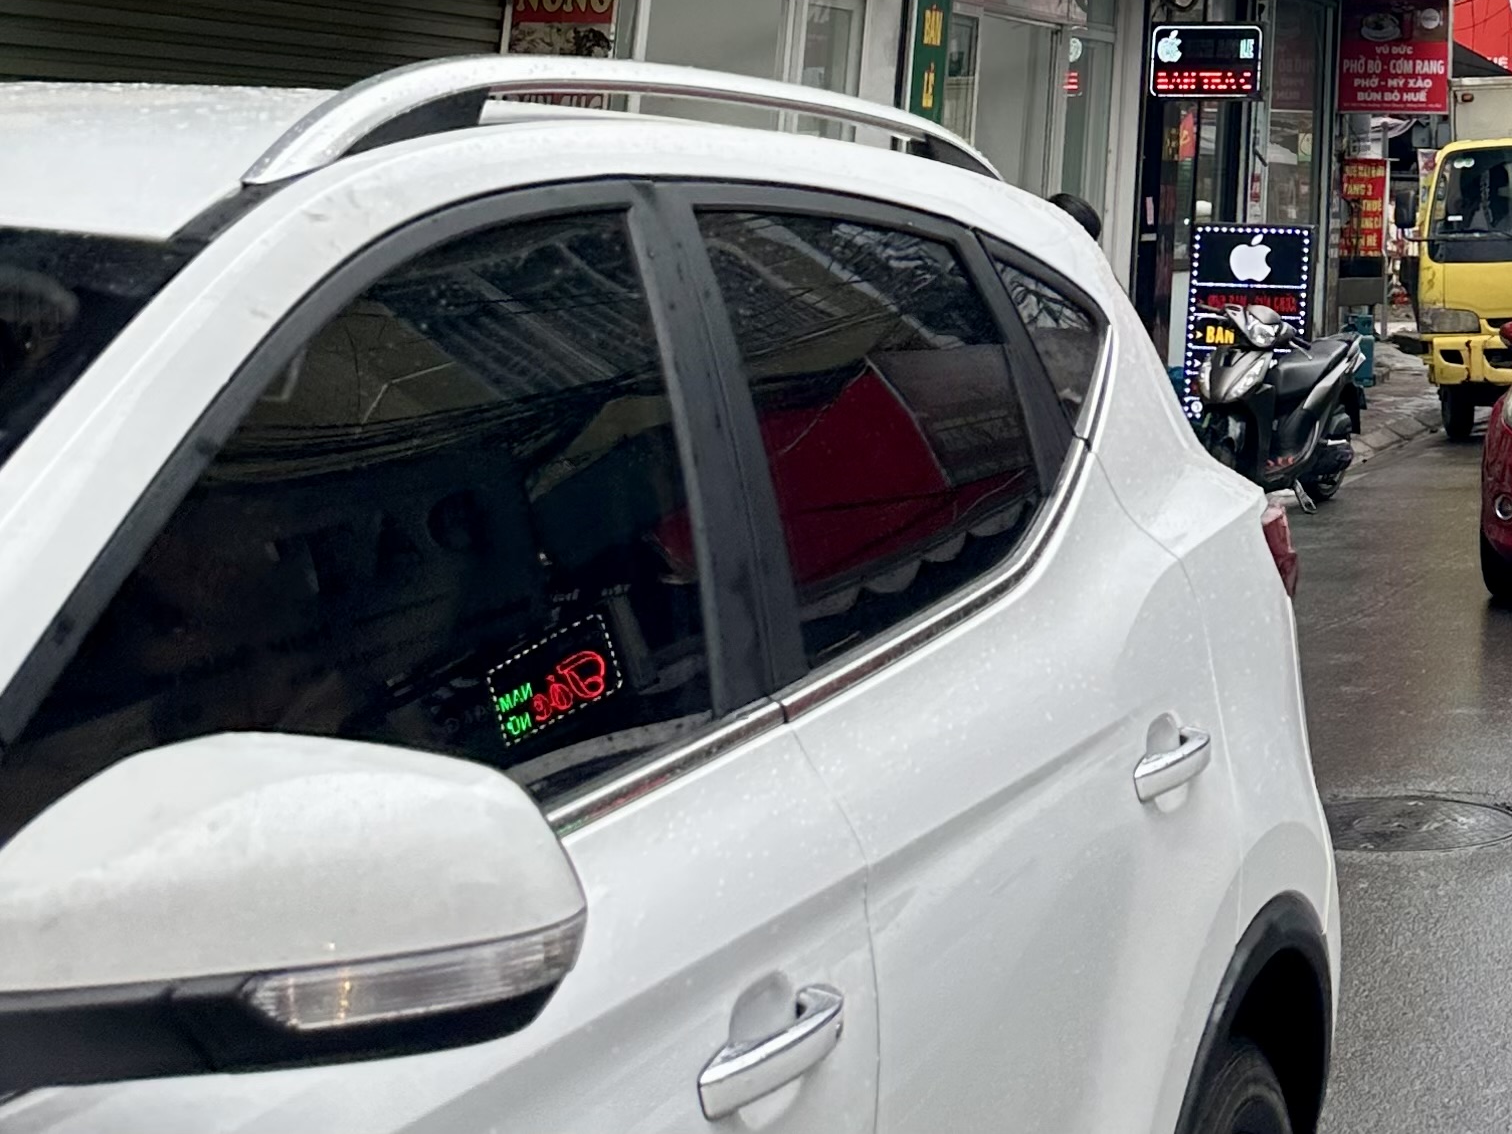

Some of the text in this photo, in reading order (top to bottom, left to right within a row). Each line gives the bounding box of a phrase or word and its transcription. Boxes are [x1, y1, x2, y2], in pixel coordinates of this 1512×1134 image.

[1415, 60, 1445, 75] RANG
[1408, 76, 1433, 88] XÀO
[1357, 90, 1382, 101] BÚN
[1402, 89, 1428, 102] HUẾ
